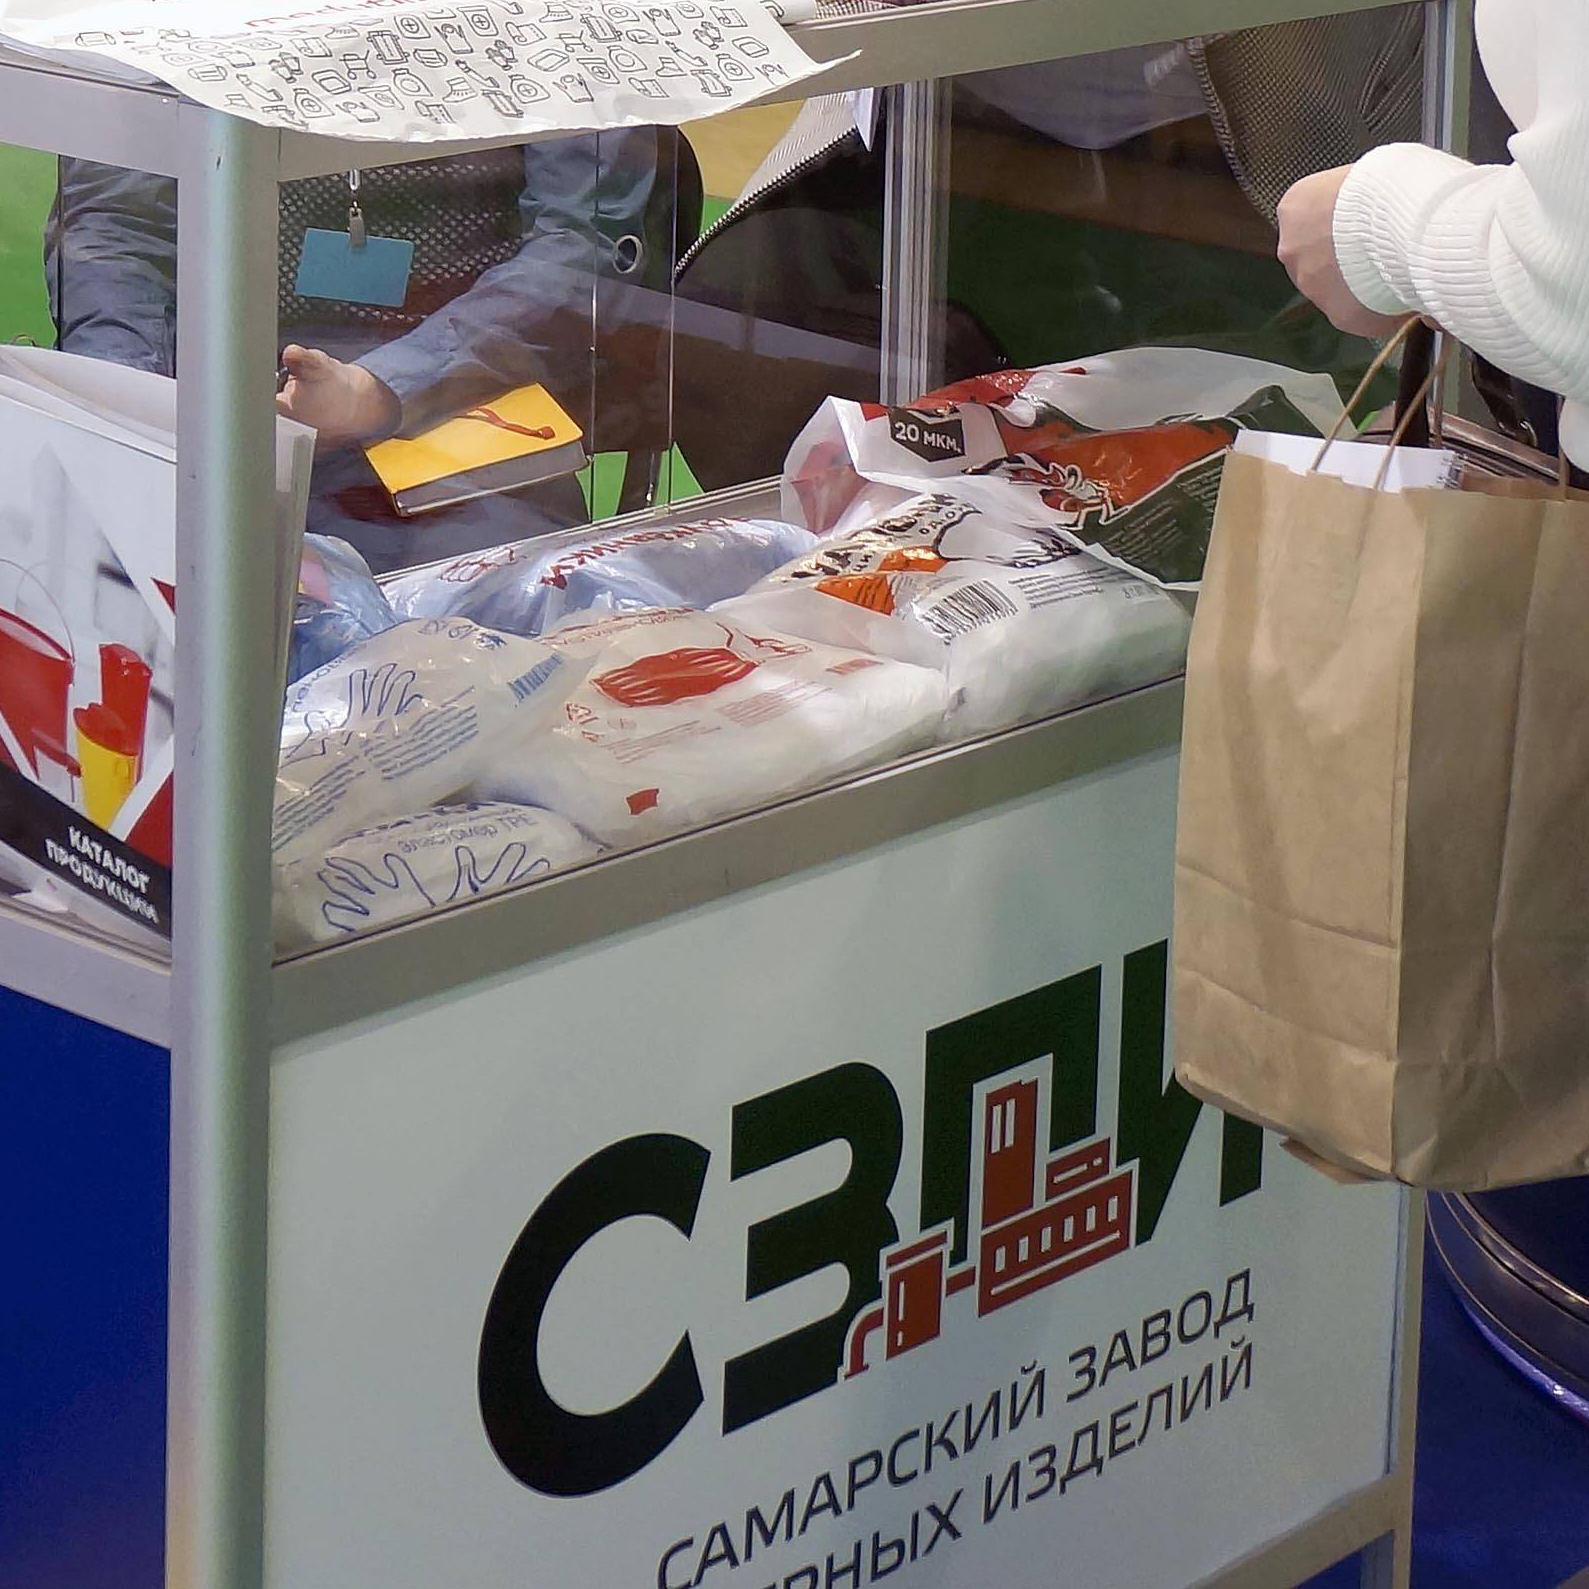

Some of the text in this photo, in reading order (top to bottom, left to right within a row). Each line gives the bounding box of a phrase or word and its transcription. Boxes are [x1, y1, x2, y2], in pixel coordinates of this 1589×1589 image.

[893, 422, 920, 443] 20
[44, 838, 159, 925] ПРОДУКЦИИ
[67, 825, 150, 894] КАТАЛОГ
[477, 938, 1263, 1499] СЗПИ
[657, 1267, 1255, 1589] САМАРСКИЙ ЗАВОД
[758, 1335, 1254, 1589] РНЫХ ИЗДЕЛИЙ
